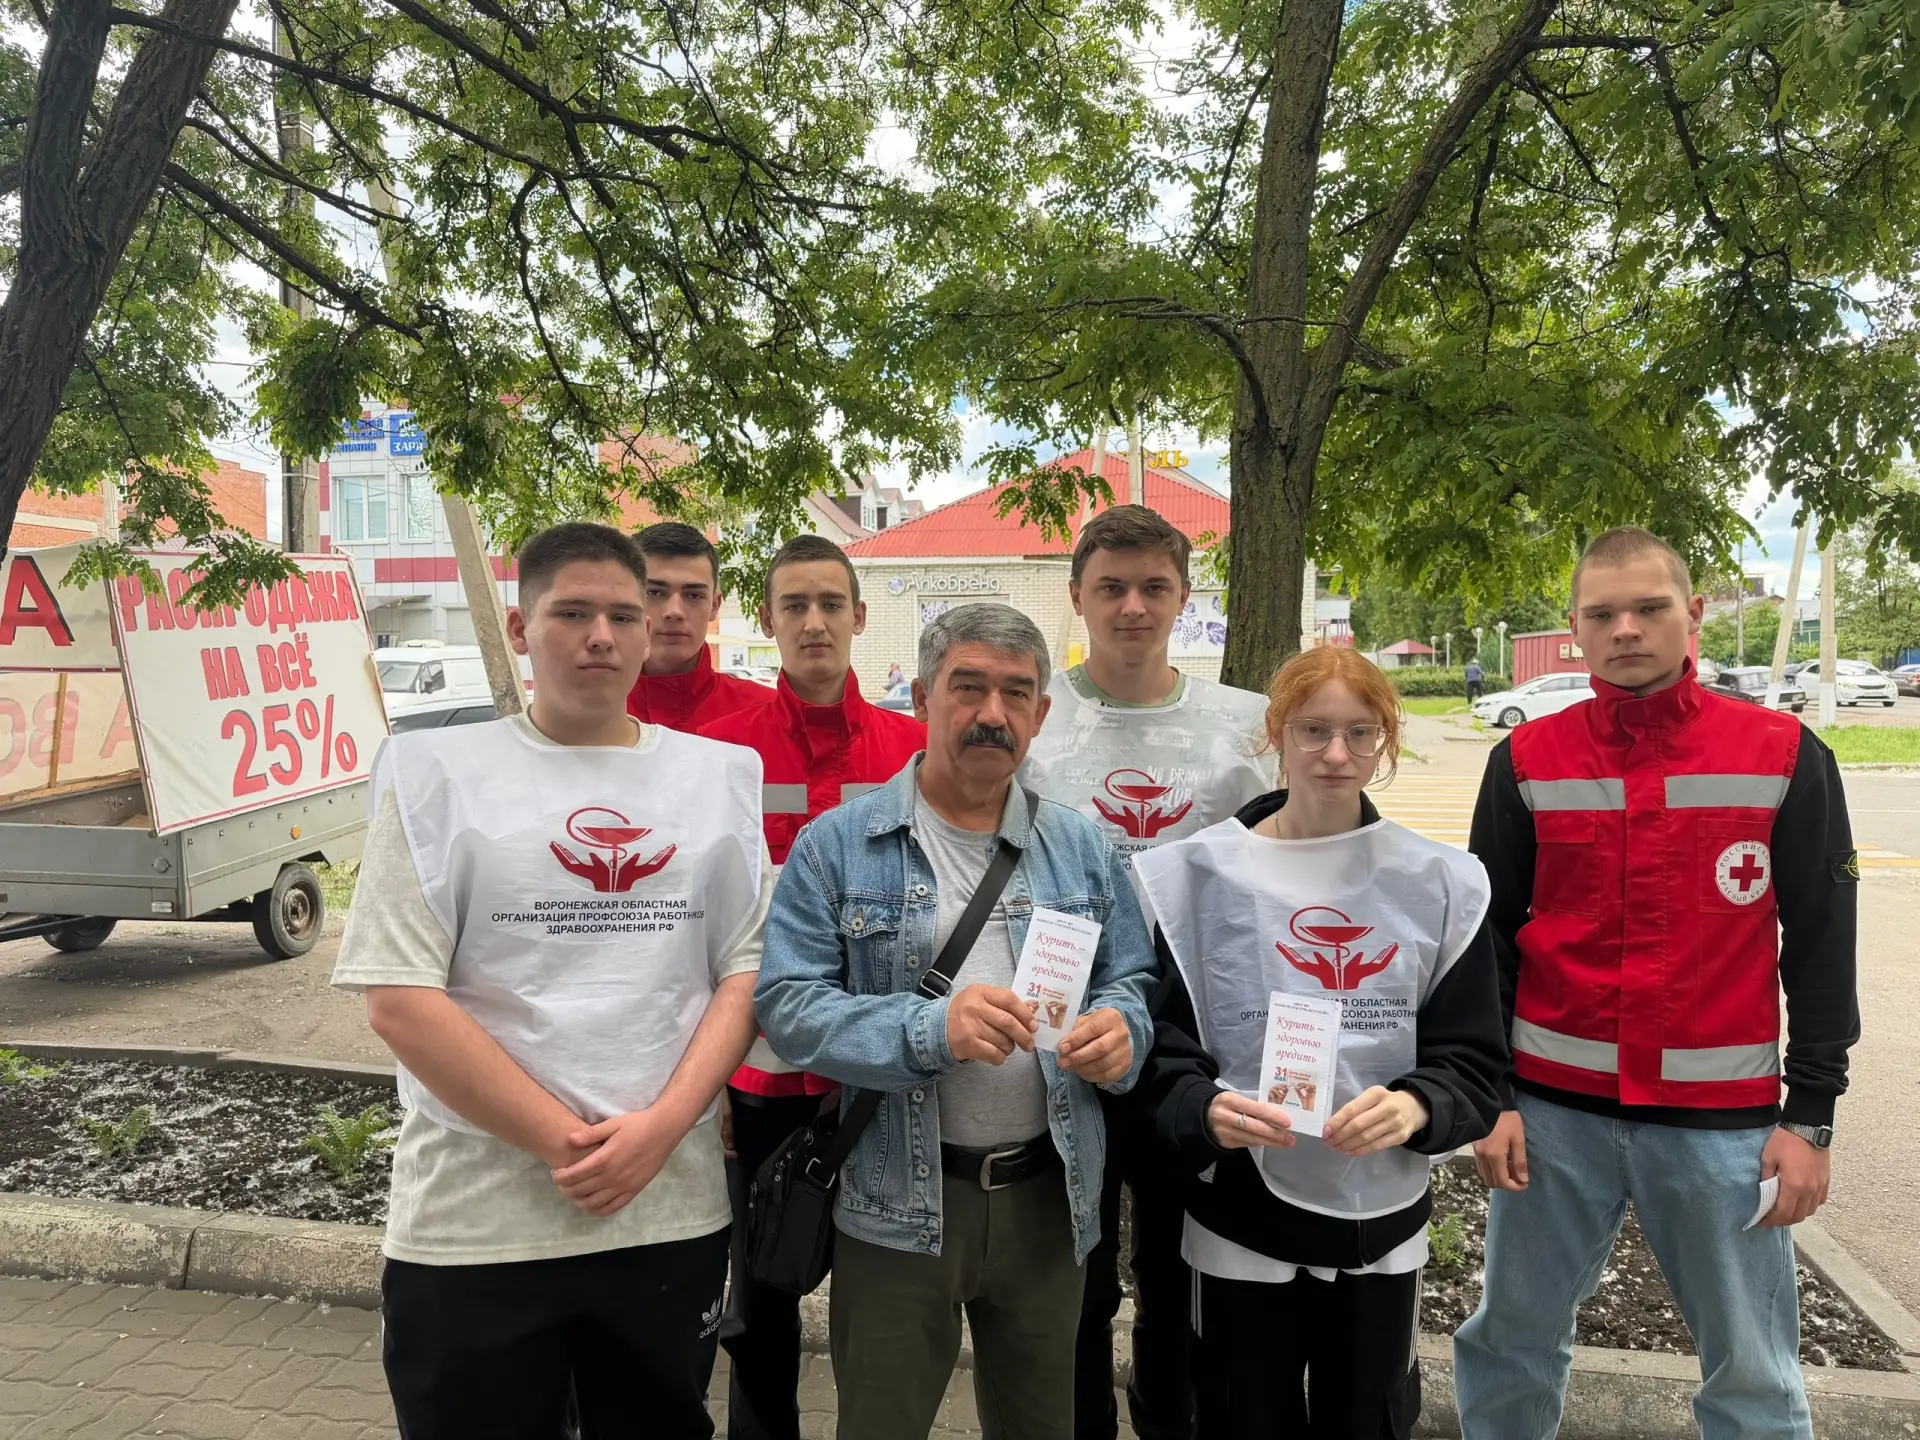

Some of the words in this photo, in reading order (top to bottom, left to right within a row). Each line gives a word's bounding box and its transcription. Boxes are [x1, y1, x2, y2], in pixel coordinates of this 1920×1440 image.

[200, 646, 251, 701] НА
[256, 632, 318, 694] ВСЁ
[221, 694, 358, 798] 25%
[1112, 843, 1147, 851] ЕЖСКАЯ
[534, 901, 619, 910] ВОРОНЕЖСКАЯ
[621, 900, 687, 909] ОБЛАСТНАЯ
[491, 913, 576, 924] ОРГАНИЗАЦИЯ
[578, 912, 650, 921] ПРОФСОЮЗА
[546, 923, 655, 934] ЗДРАВООХРАНЕНИЯ
[658, 923, 674, 932] РФ
[1036, 931, 1076, 950] Курить
[1033, 947, 1080, 968] здоровью
[1031, 965, 1074, 982] вредить
[1028, 982, 1042, 994] 31
[1351, 998, 1408, 1007] ОБЛАСТНАЯ
[1240, 1010, 1269, 1020] ОРГАН
[1341, 1010, 1380, 1019] СОЮЗА
[1276, 1016, 1315, 1031] Курить
[1340, 1021, 1384, 1030] РАНЕНИЯ
[1386, 1021, 1399, 1030] РФ
[1275, 1032, 1321, 1048] здоровью
[1275, 1048, 1317, 1063] вредить
[1275, 1066, 1288, 1077] 31
